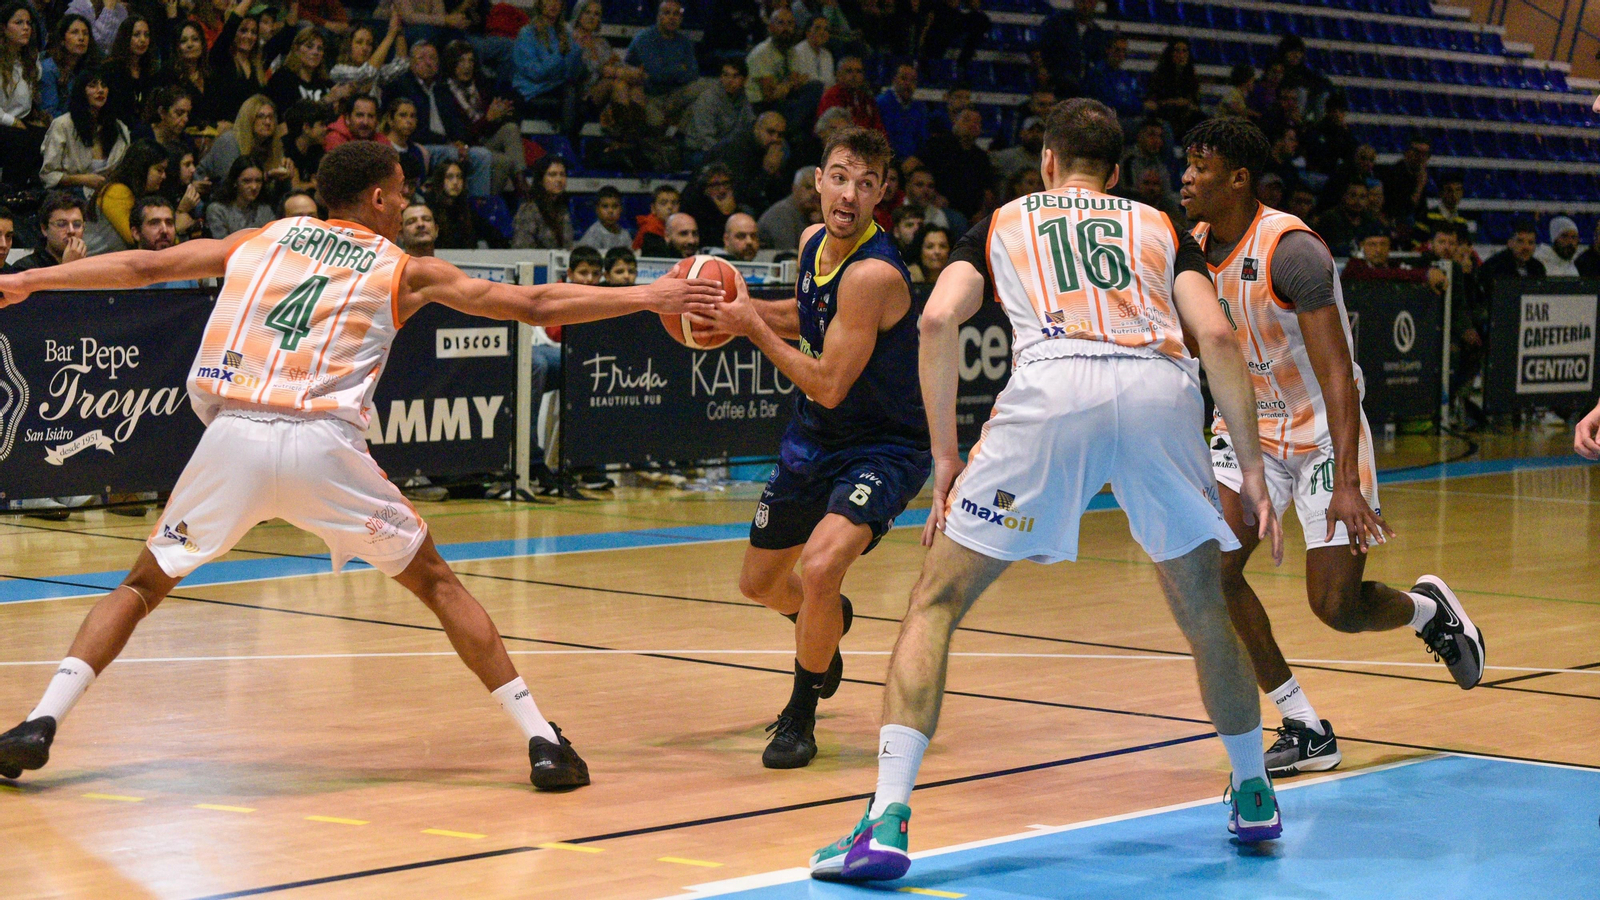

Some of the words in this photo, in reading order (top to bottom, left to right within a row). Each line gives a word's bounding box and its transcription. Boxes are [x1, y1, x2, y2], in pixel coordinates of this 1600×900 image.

[276, 226, 377, 274] BERNARD
[1037, 216, 1131, 294] 16
[265, 274, 332, 351] 4
[1525, 302, 1550, 322] BAR
[443, 335, 501, 350] DISCOS
[1523, 322, 1592, 349] CAFETERÍA
[44, 339, 74, 362] Bar
[80, 337, 140, 380] Pepe
[1524, 358, 1588, 381] CENTRO
[197, 366, 261, 389] maxoil
[582, 353, 668, 394] Frida
[39, 363, 188, 443] Troya
[589, 396, 639, 407] BEAUTIFUL
[644, 395, 661, 405] PUB
[706, 402, 744, 421] Coffee
[747, 401, 757, 418] &
[760, 400, 779, 418] Bar
[25, 428, 43, 442] San
[45, 426, 73, 441] Isidro
[59, 441, 81, 456] desde
[82, 433, 99, 447] 1951
[859, 472, 883, 487] vive
[848, 483, 872, 507] 6
[961, 497, 1035, 532] maxoil
